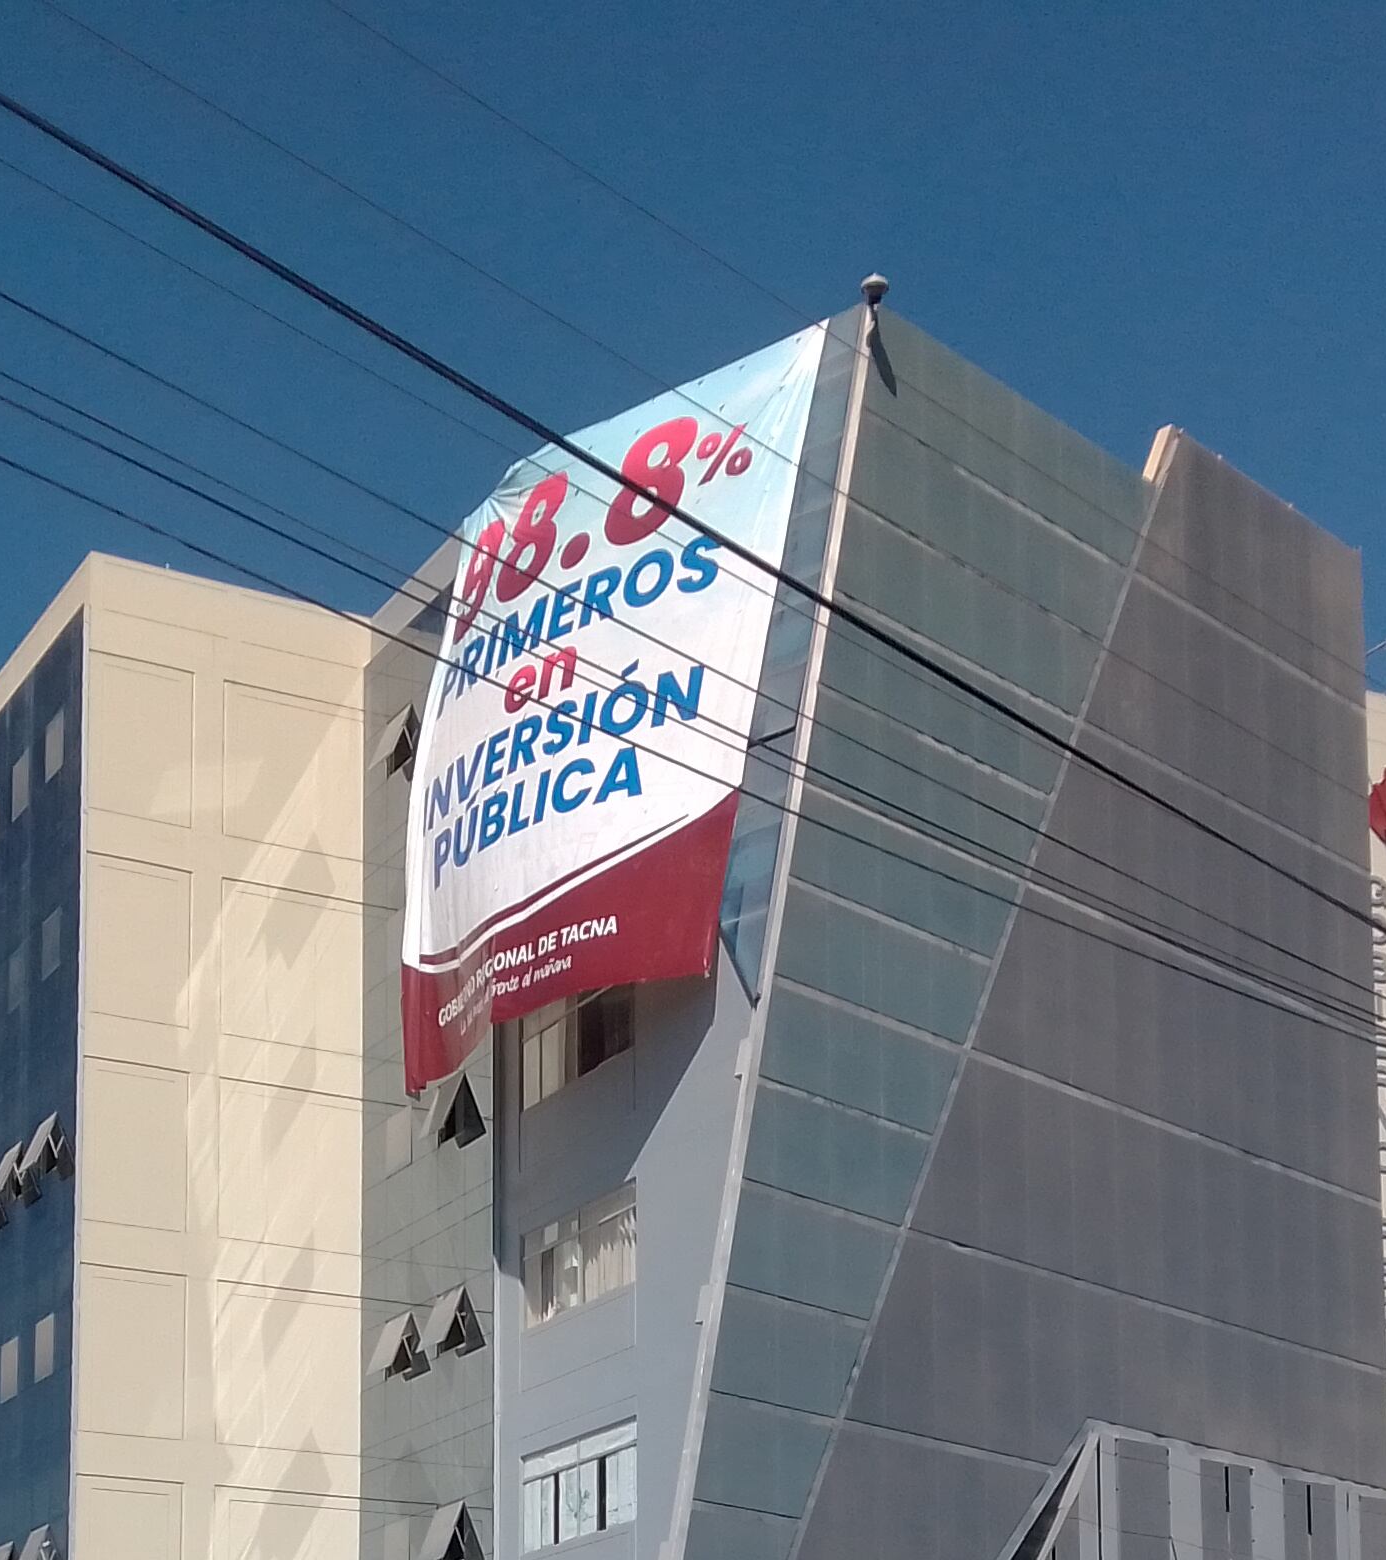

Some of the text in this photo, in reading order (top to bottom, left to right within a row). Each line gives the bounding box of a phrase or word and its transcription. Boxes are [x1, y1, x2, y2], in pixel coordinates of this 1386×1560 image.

[437, 534, 721, 719] PRIMEROS
[504, 646, 577, 714] en
[423, 658, 705, 836] INVERSIÓN
[434, 746, 643, 890] PÚBLICA
[476, 944, 535, 988] RGONAL
[538, 931, 557, 958] DE
[561, 915, 618, 947] TACNA
